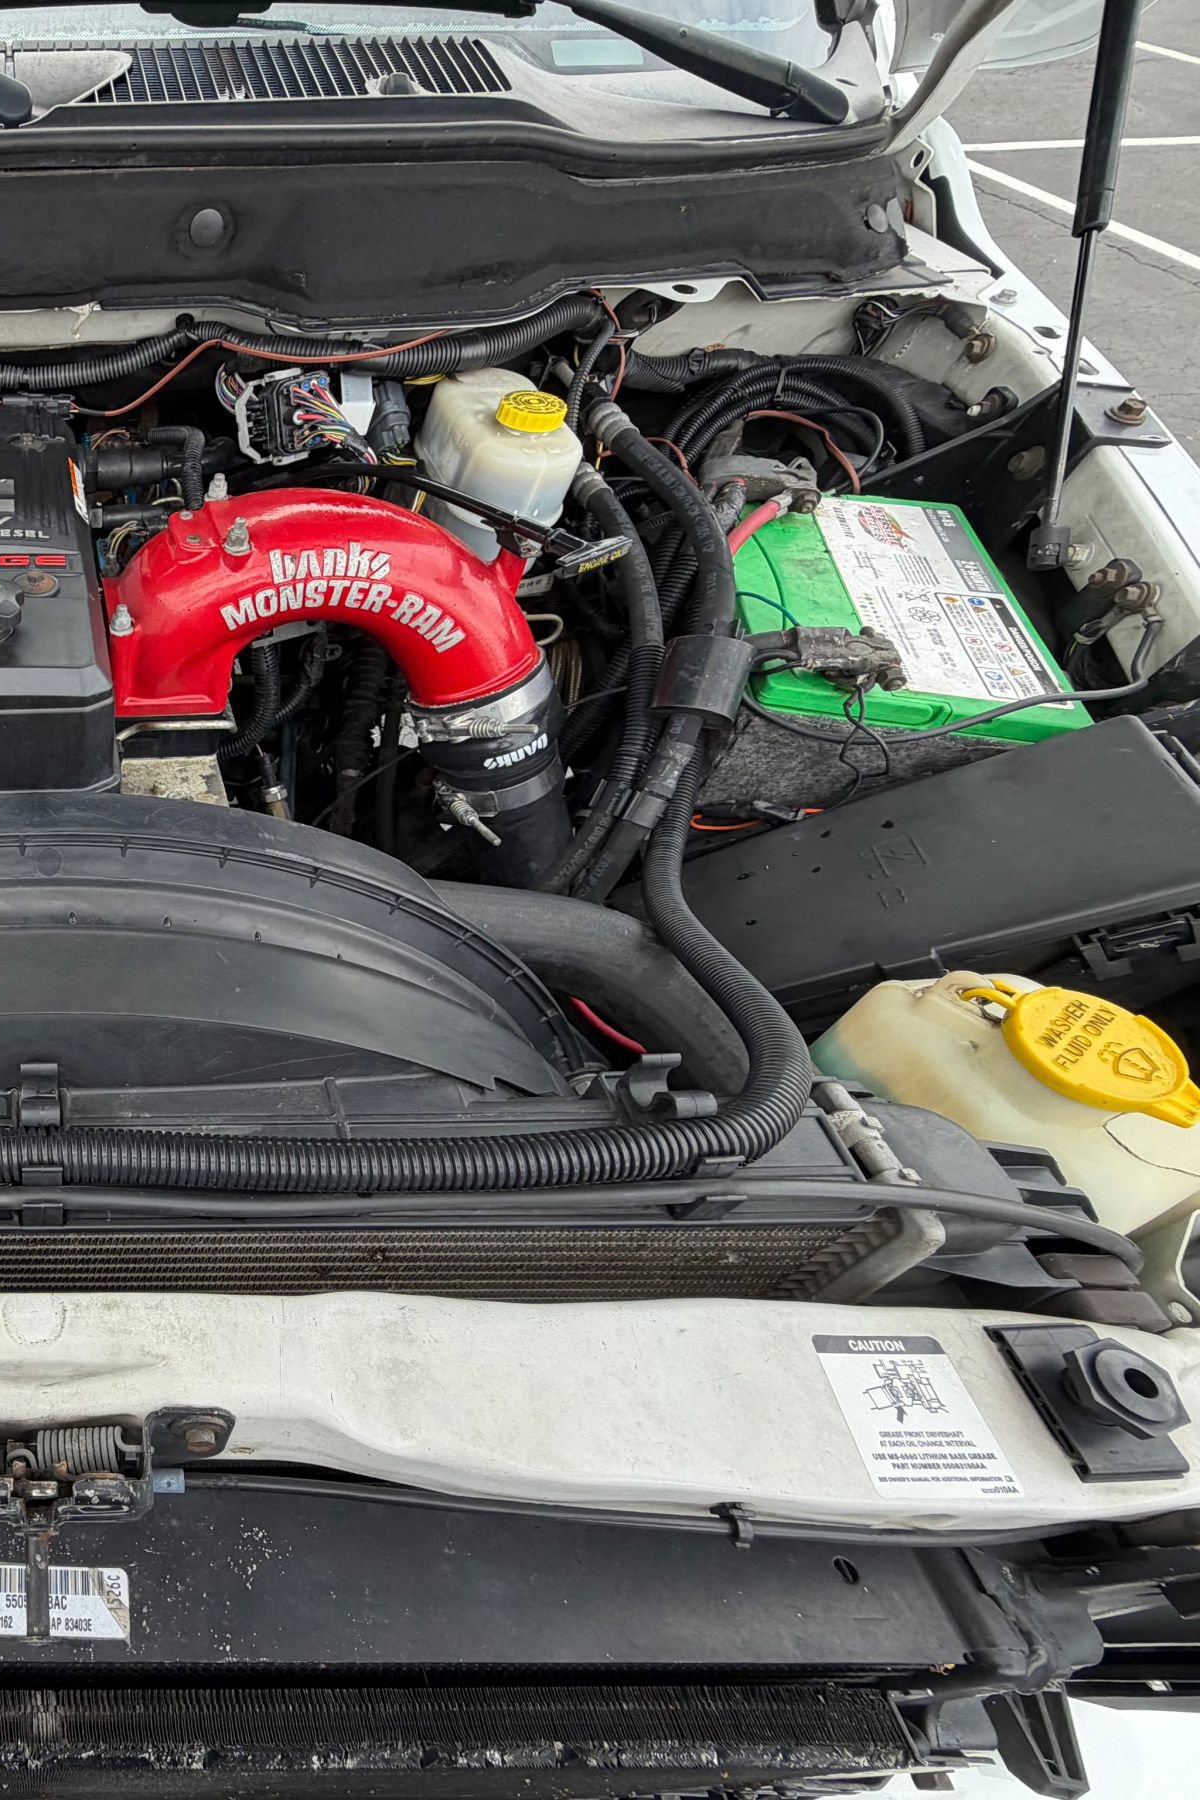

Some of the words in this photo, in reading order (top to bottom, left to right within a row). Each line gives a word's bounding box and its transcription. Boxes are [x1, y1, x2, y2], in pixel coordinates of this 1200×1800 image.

[578, 553, 610, 573] ENGINE
[219, 579, 466, 653] MONSTER-RAM
[1036, 999, 1090, 1050] WASHER
[1053, 1035, 1092, 1072] FLUID
[1084, 1005, 1117, 1037] ONLY
[848, 1339, 906, 1352] CAUTION
[891, 1462, 910, 1470] PART
[910, 1462, 942, 1470] NUMBER
[64, 1618, 92, 1632] 83403E
